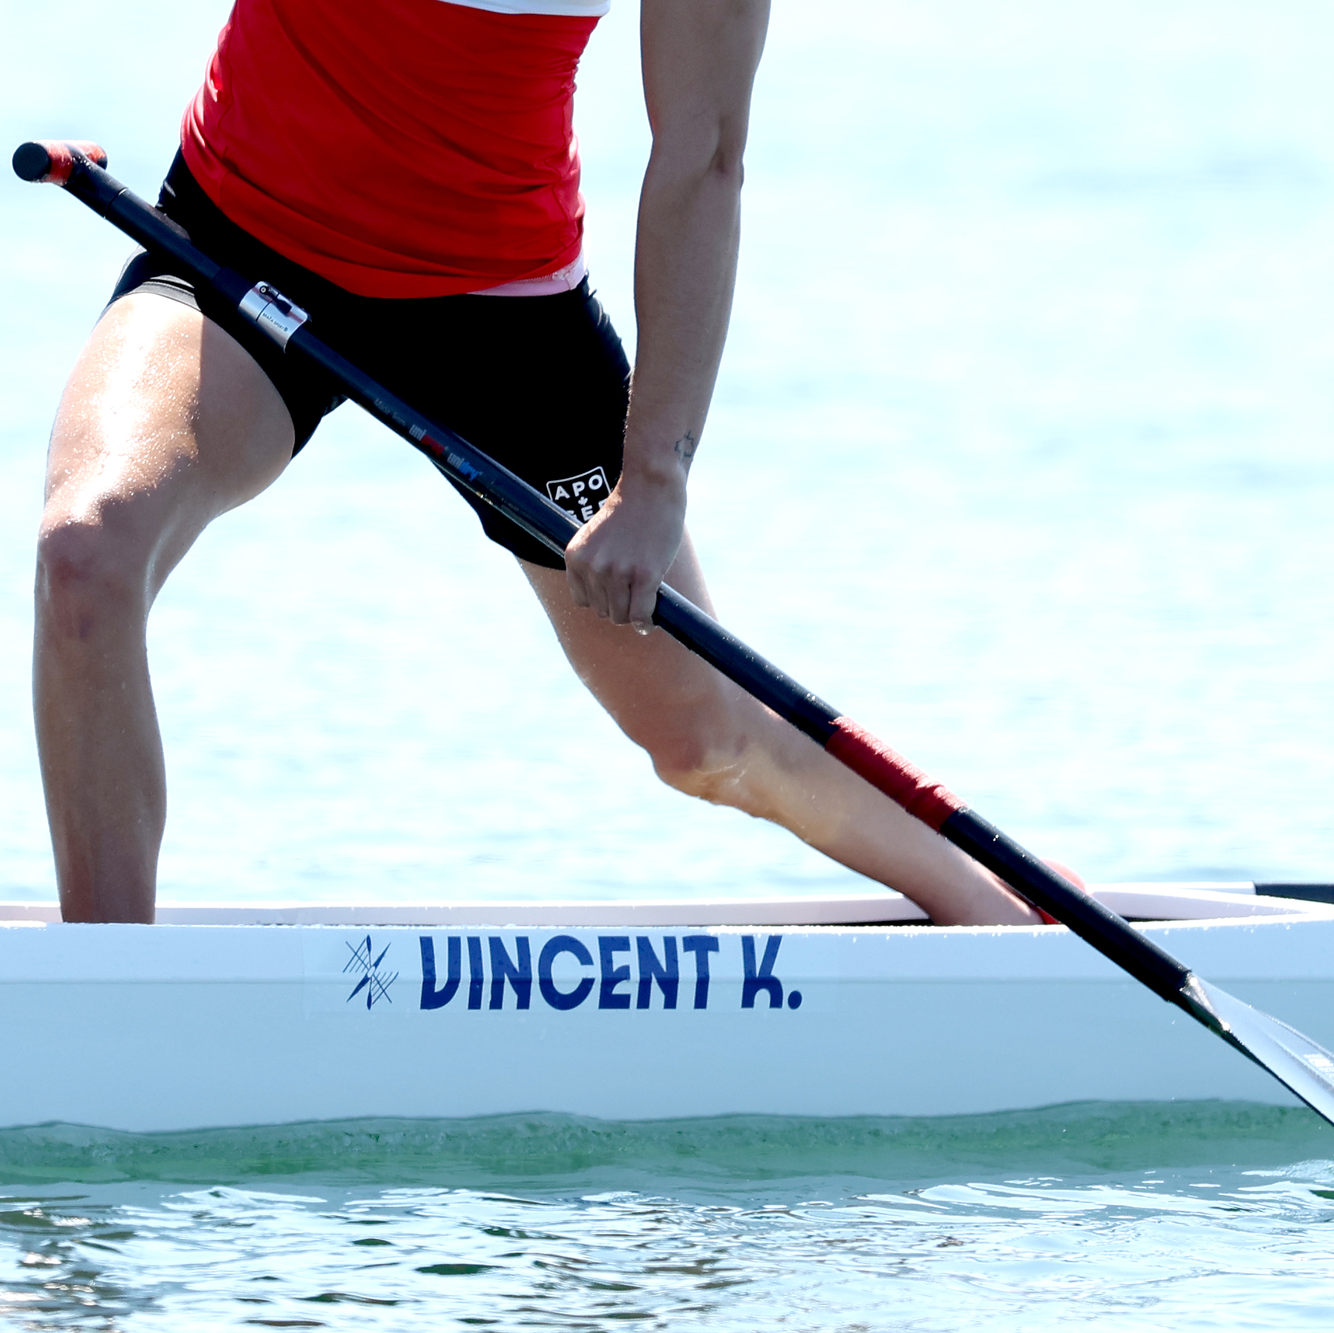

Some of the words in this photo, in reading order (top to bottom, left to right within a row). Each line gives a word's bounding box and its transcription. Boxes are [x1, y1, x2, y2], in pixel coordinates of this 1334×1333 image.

[554, 474, 603, 500] APO
[419, 935, 719, 1010] VINCENT
[741, 935, 802, 1010] K.
